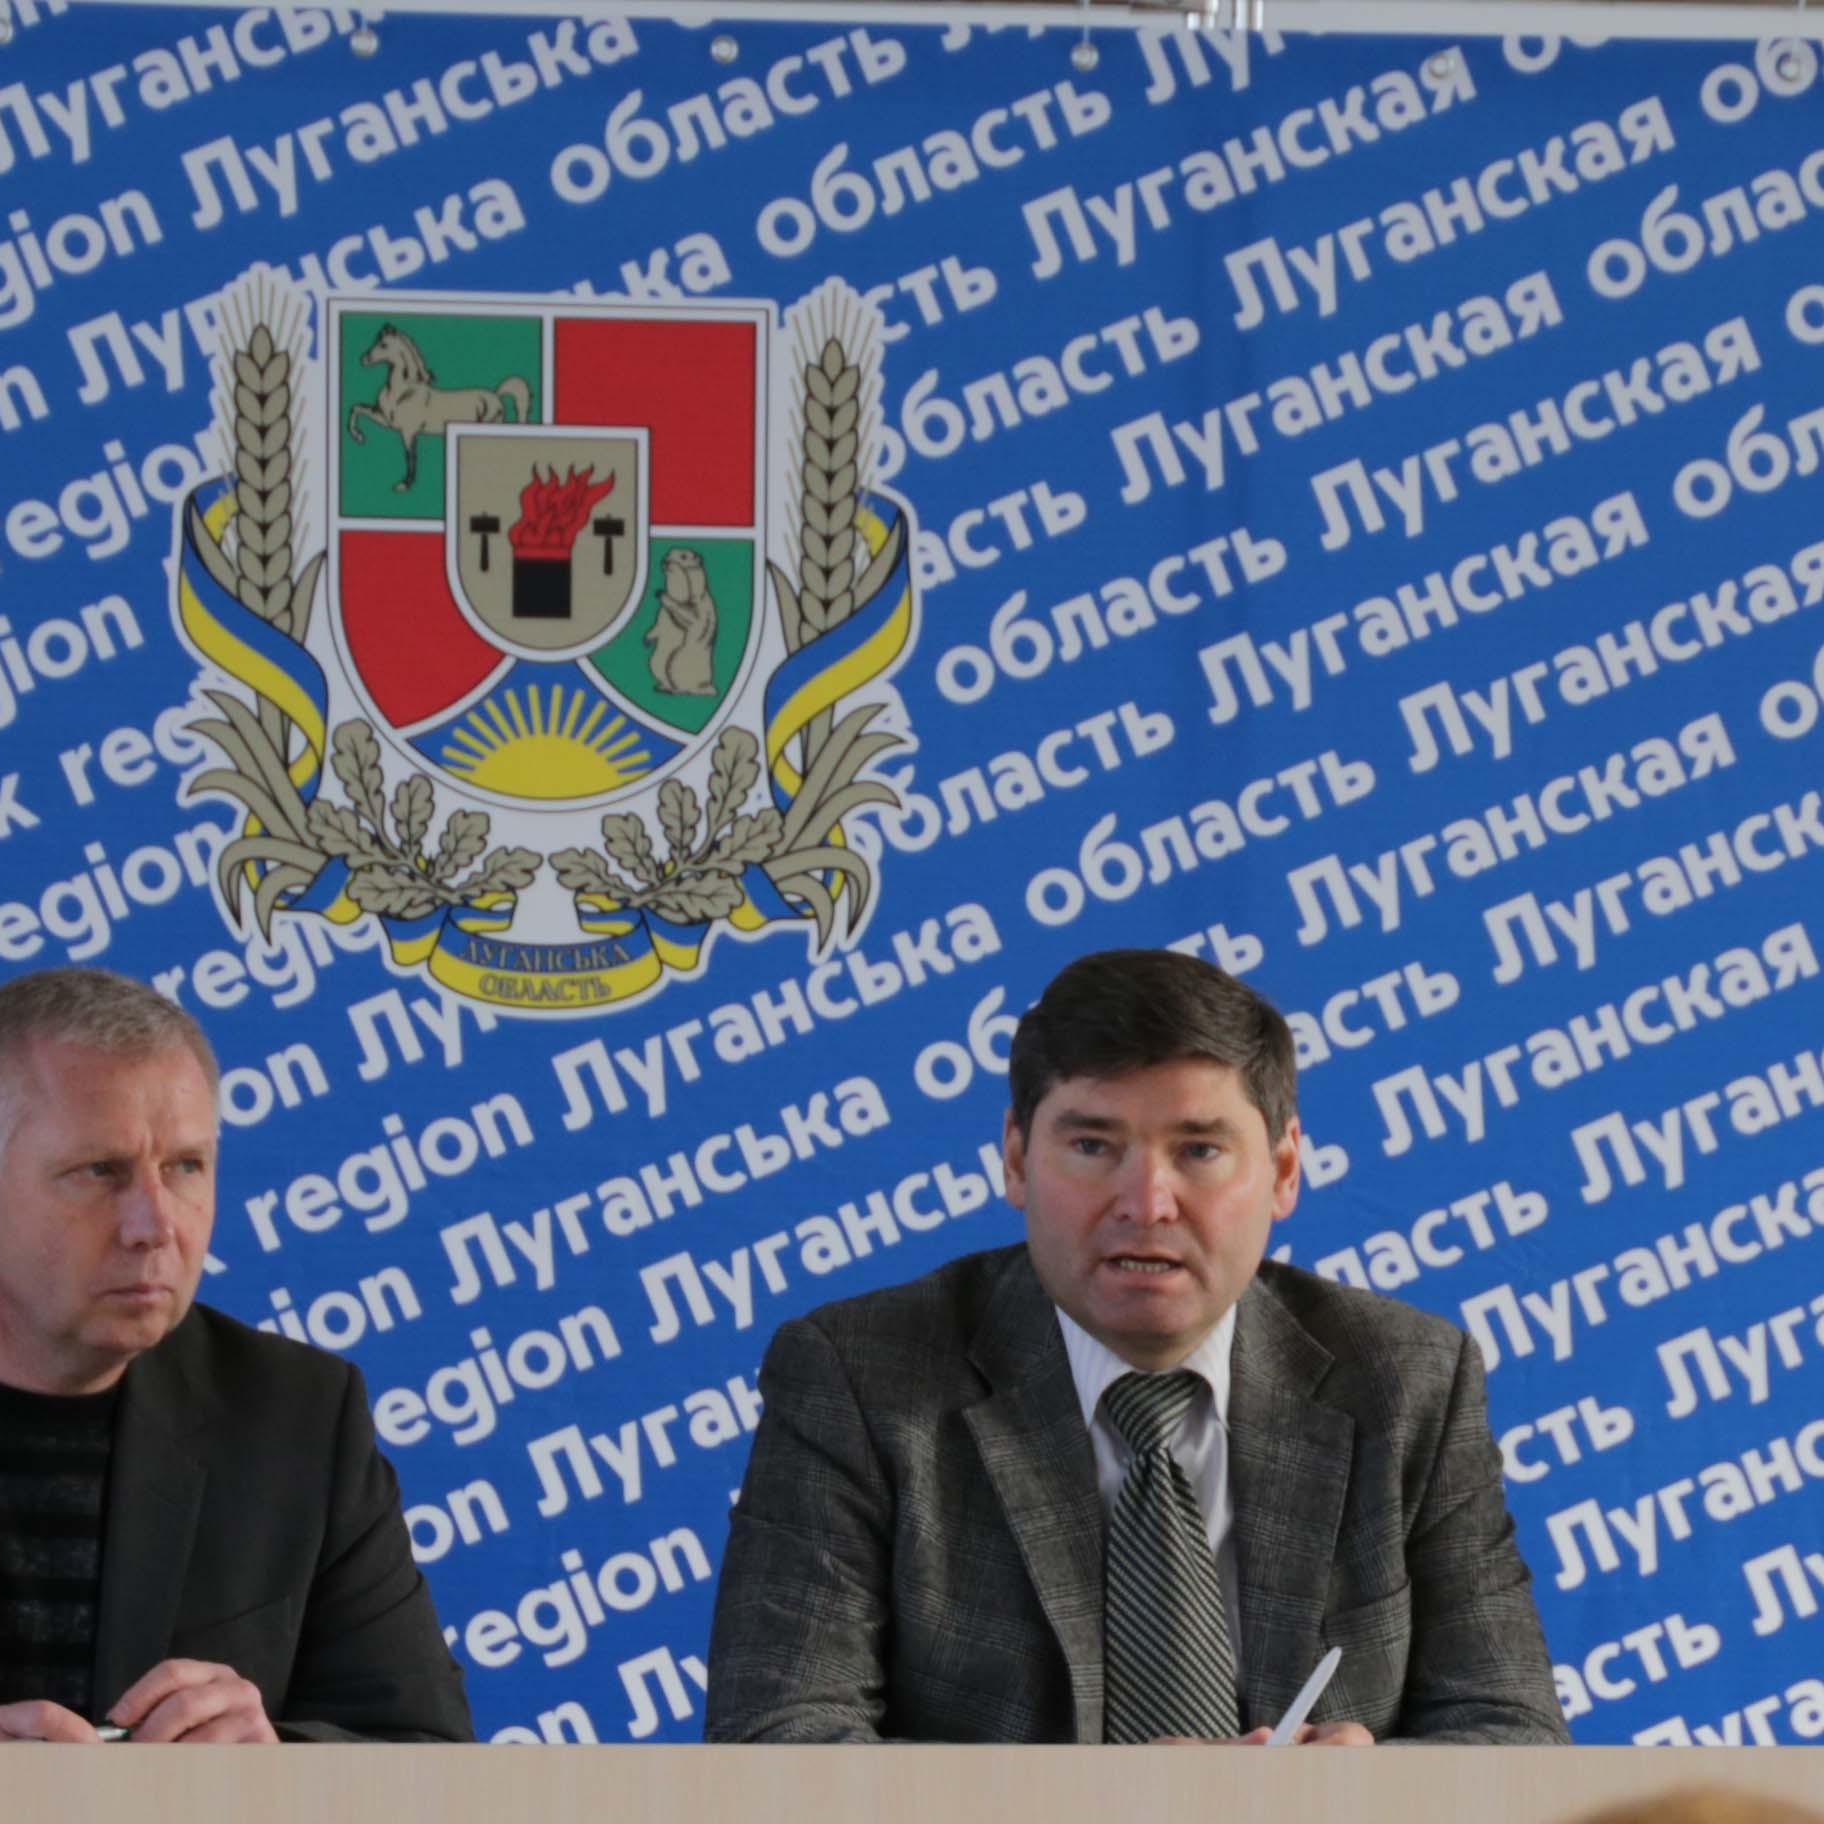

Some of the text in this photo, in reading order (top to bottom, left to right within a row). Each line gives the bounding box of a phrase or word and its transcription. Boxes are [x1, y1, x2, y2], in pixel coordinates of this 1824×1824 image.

[182, 19, 639, 230] Луганська
[550, 27, 906, 204] область
[756, 81, 1111, 258] область
[1022, 46, 1477, 280] Луганская
[1224, 96, 1675, 330] Луганская
[1111, 271, 1563, 504] Луганская
[935, 528, 1287, 704] область
[1311, 317, 1761, 551] Луганская
[1199, 491, 1649, 725] Луганская
[245, 1093, 534, 1252] region
[552, 903, 1002, 1132] Луганська
[1025, 750, 1376, 927] область
[440, 1076, 890, 1305] Луганська
[1287, 713, 1736, 946] Луганская
[1372, 922, 1820, 1157] Луганская
